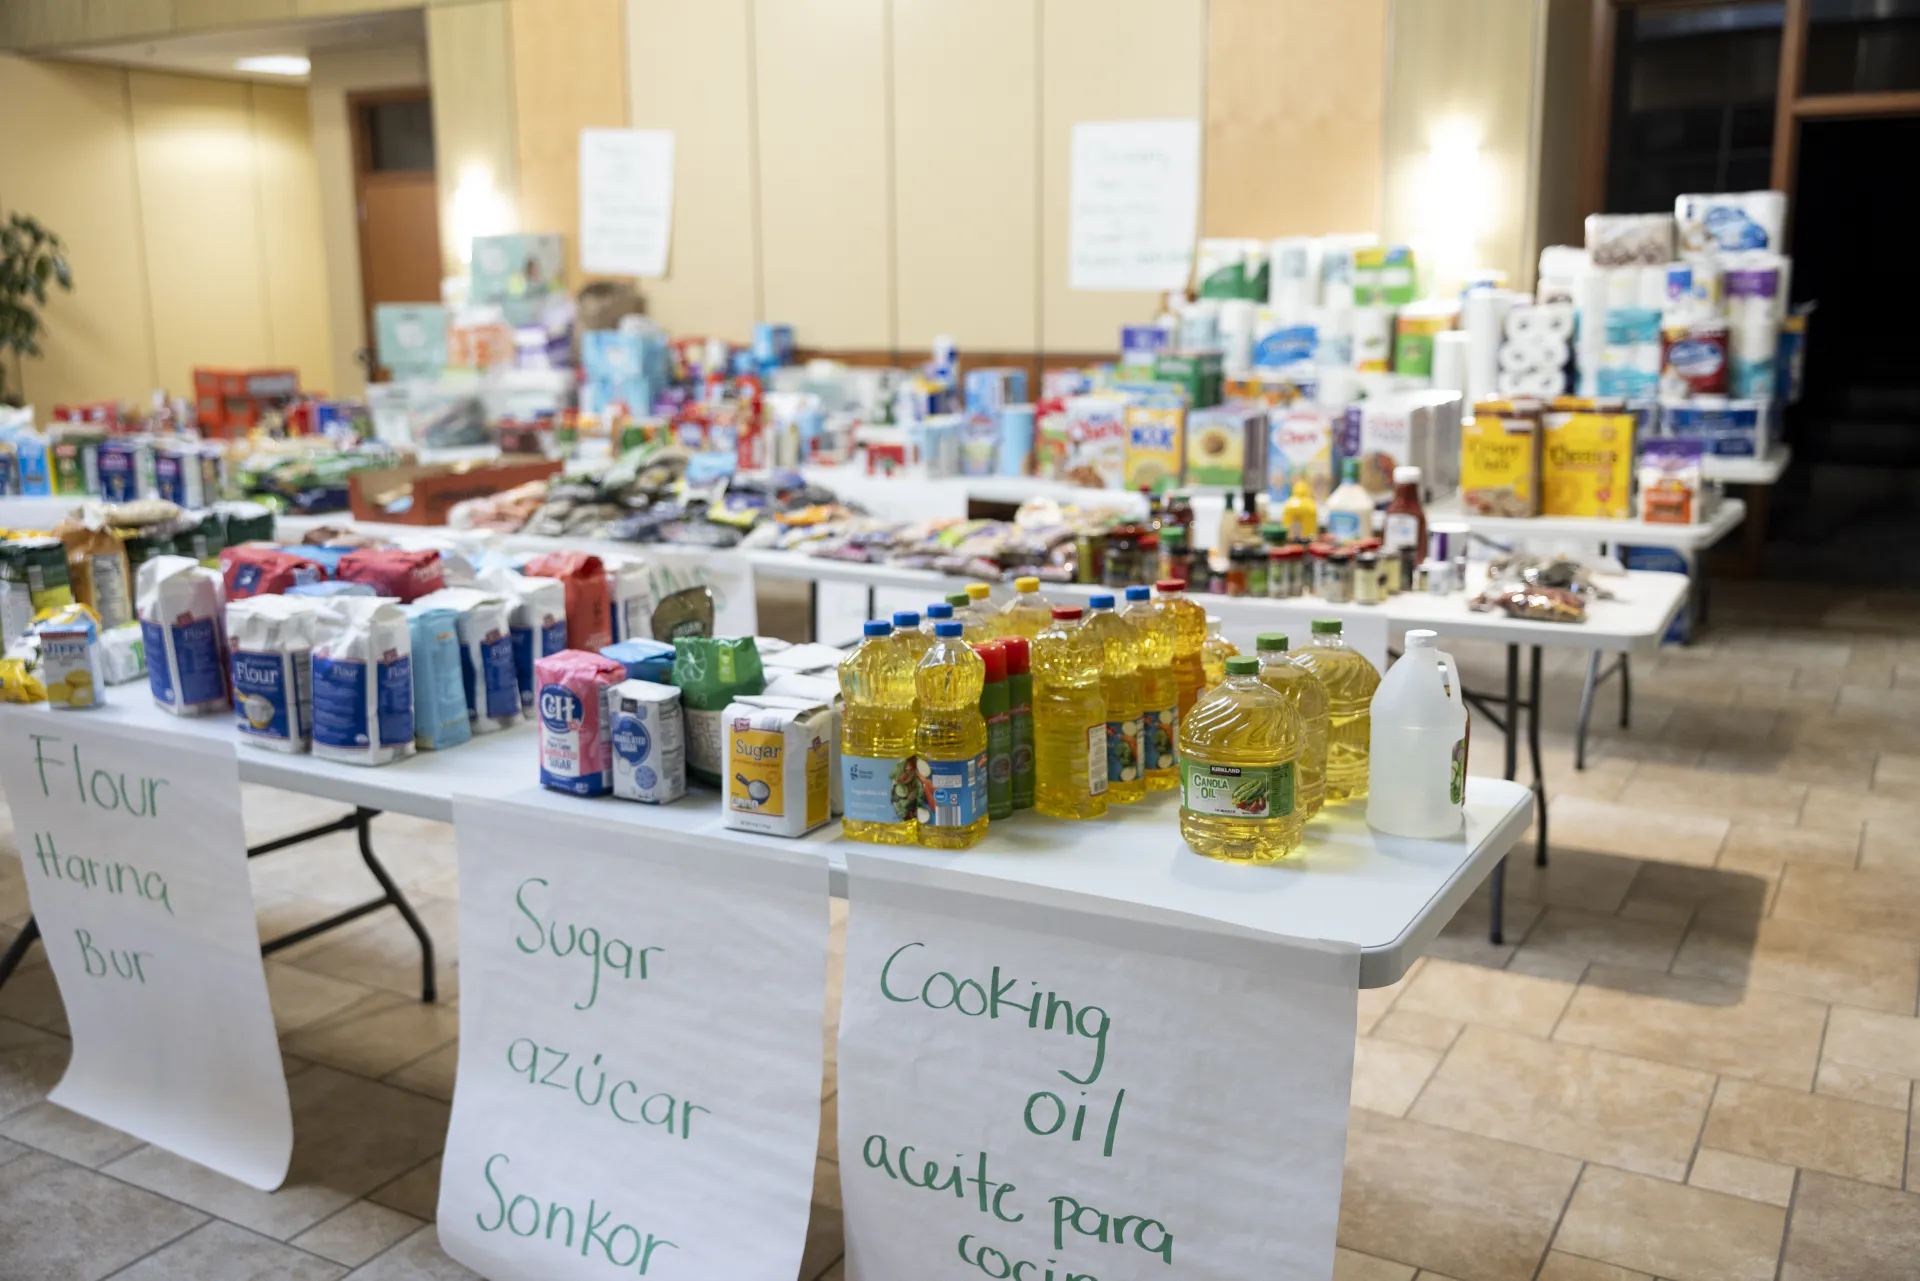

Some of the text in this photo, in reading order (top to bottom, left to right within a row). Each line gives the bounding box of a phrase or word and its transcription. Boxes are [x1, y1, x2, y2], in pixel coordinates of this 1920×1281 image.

[236, 660, 279, 685] Flour
[541, 692, 575, 722] C&H
[30, 734, 169, 818] Flour
[549, 759, 573, 771] SUGAR
[735, 738, 782, 762] Sugar
[1194, 774, 1229, 789] CANOLA
[1211, 766, 1240, 774] KIRKLAND
[1201, 787, 1216, 799] OIL
[35, 832, 174, 916] Harina
[75, 928, 153, 985] Bur
[515, 878, 665, 1011] Sugar
[880, 942, 1110, 1086] Cooking
[507, 1038, 711, 1139] azúcar
[1023, 1089, 1126, 1157] oil
[863, 1135, 1024, 1223] aceite
[477, 1154, 679, 1276] Sonkor
[1048, 1196, 1174, 1265] para
